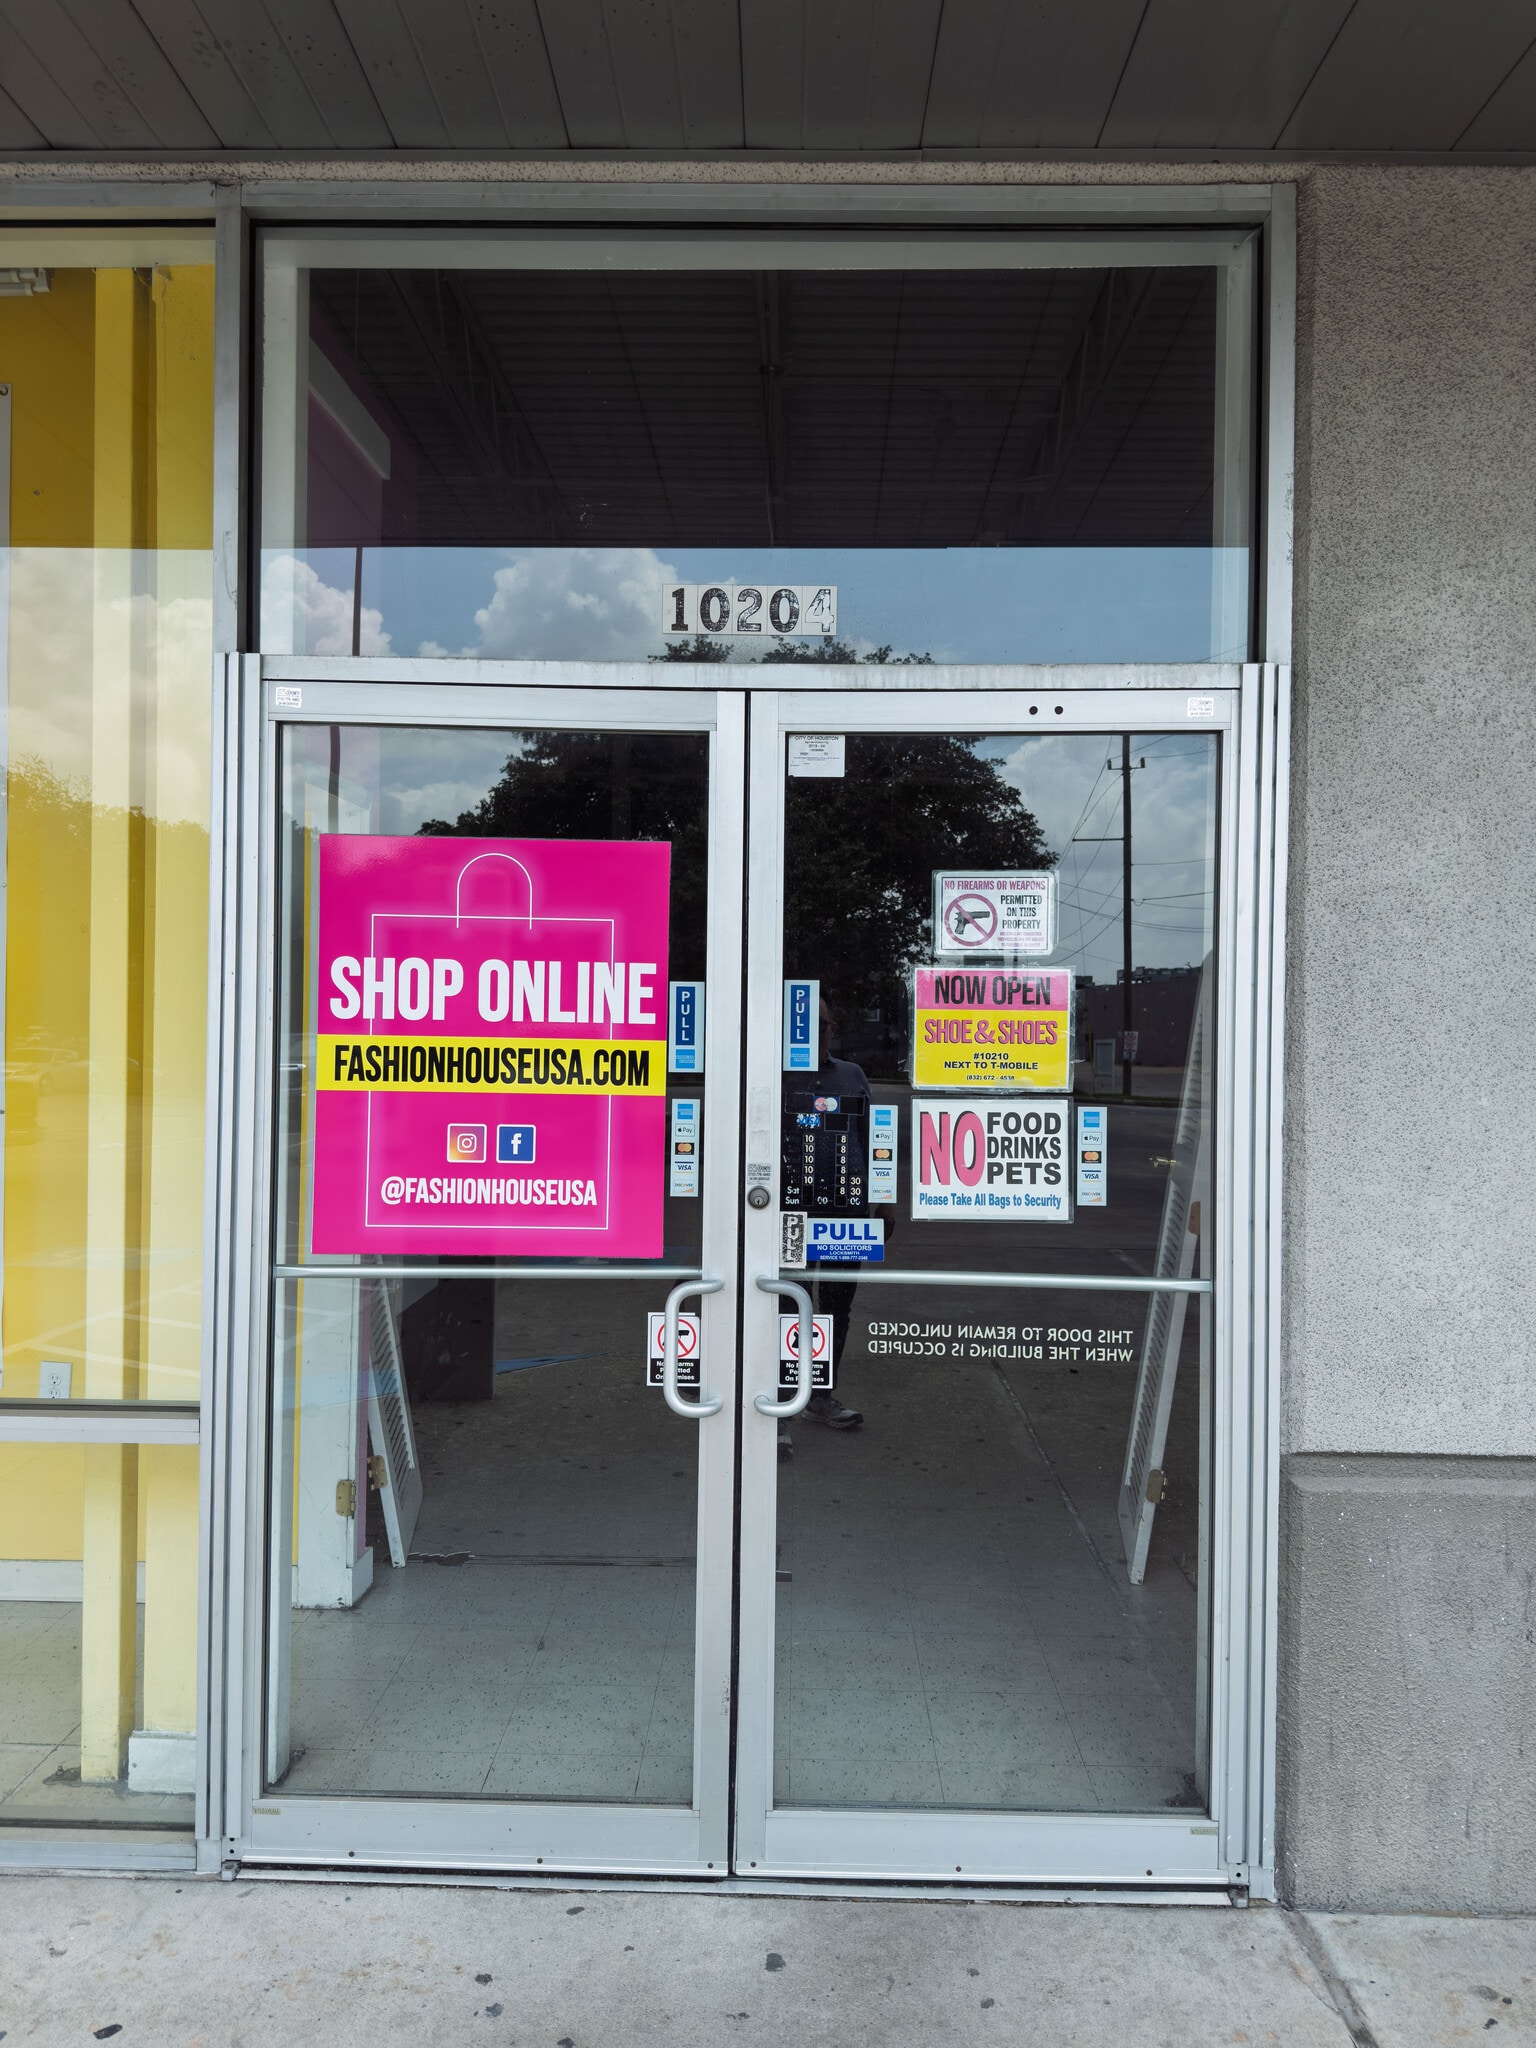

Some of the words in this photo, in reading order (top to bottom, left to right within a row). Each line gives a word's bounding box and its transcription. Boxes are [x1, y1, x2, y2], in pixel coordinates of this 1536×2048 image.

[671, 588, 834, 632] 10204
[945, 880, 954, 890] NO
[958, 880, 994, 890] FIREARMS
[996, 880, 1007, 890] OR
[1010, 880, 1046, 890] WEAPONS
[1000, 895, 1042, 904] PERMITTED
[1006, 907, 1016, 916] ON
[1019, 908, 1036, 917] THIS
[1002, 920, 1040, 929] PROPERTY
[330, 956, 464, 1021] SHOP
[478, 959, 657, 1025] ONLINE
[935, 975, 986, 1004] NOW
[992, 976, 1050, 1005] OPEN
[681, 991, 690, 1041] PULL
[796, 989, 805, 1040] PULL
[924, 1019, 972, 1044] SHOE
[974, 1019, 995, 1045] &
[998, 1020, 1058, 1045] SHOES
[334, 1044, 650, 1087] FASHIONHOUSEUSA.COM
[990, 1062, 1038, 1070] T-MOBILE
[987, 1112, 1062, 1134] FOOD
[805, 1134, 814, 1142] 10
[841, 1136, 846, 1144] 8
[987, 1136, 1061, 1160] DRINKS
[805, 1144, 814, 1152] 10
[840, 1146, 846, 1154] 8
[920, 1111, 986, 1187] NO
[805, 1156, 814, 1164] 10
[840, 1156, 846, 1164] 8
[804, 1166, 814, 1174] 10
[840, 1166, 846, 1174] 8
[987, 1162, 1062, 1186] PETS
[804, 1176, 813, 1184] 10
[840, 1176, 846, 1184] 8
[380, 1176, 598, 1206] @FASHIONHOUSEUSA
[787, 1186, 800, 1194] Sat
[785, 1196, 800, 1204] Sun
[919, 1192, 950, 1206] Please
[951, 1192, 971, 1206] Take
[974, 1193, 986, 1206] All
[988, 1194, 1010, 1209] Bags
[1012, 1194, 1022, 1206] to
[1024, 1194, 1062, 1210] Security
[787, 1216, 800, 1260] PULL
[813, 1223, 878, 1240] PULL
